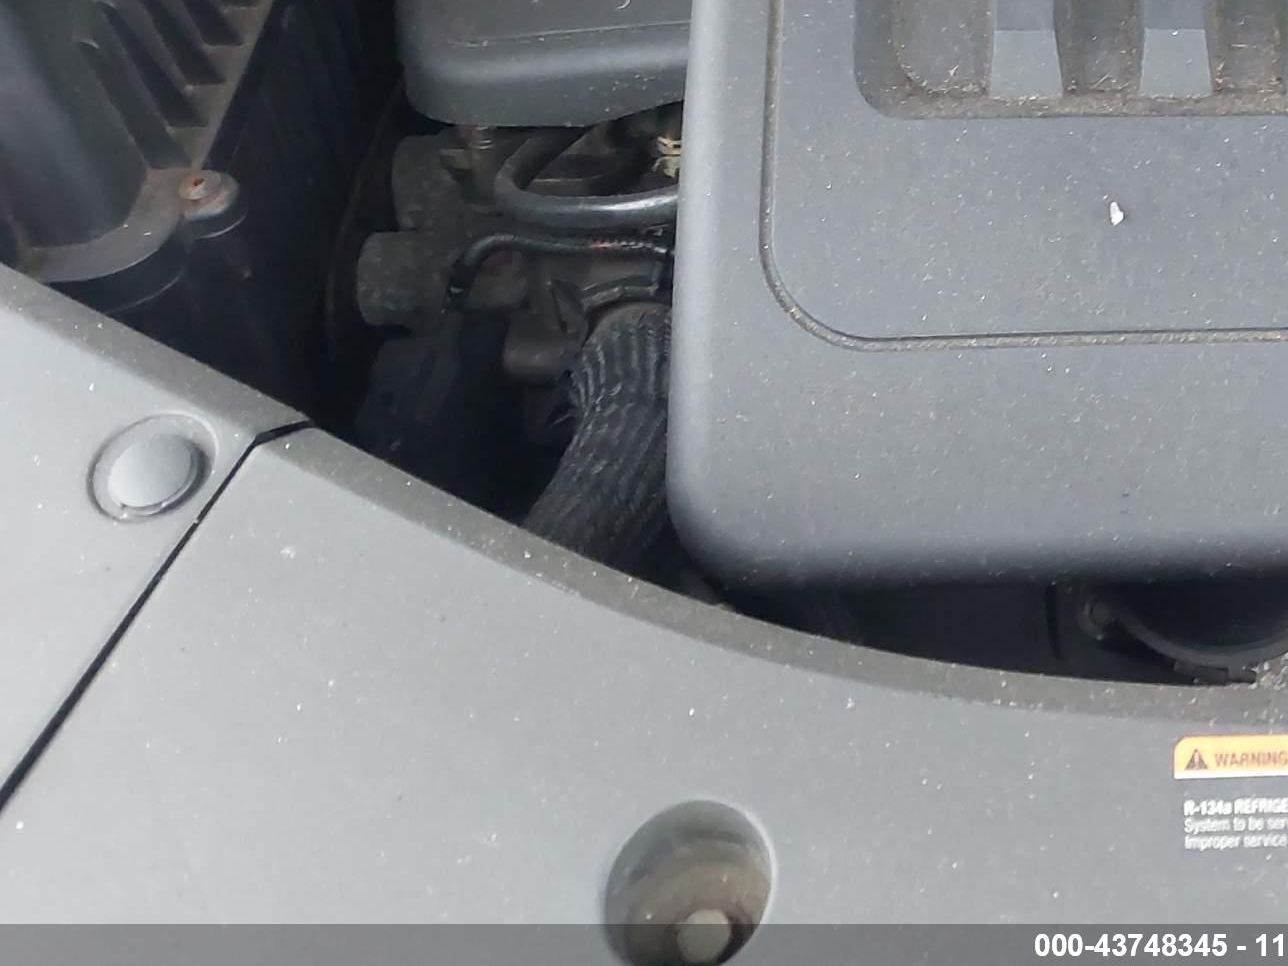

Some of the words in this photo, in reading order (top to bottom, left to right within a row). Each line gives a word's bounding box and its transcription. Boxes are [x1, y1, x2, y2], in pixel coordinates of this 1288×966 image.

[1214, 751, 1288, 767] WARNING
[1184, 799, 1232, 815] R-134a
[1184, 817, 1231, 834] System
[1233, 816, 1246, 831] to
[1248, 816, 1265, 831] be
[1184, 834, 1240, 851] Improper
[1243, 832, 1288, 847] service
